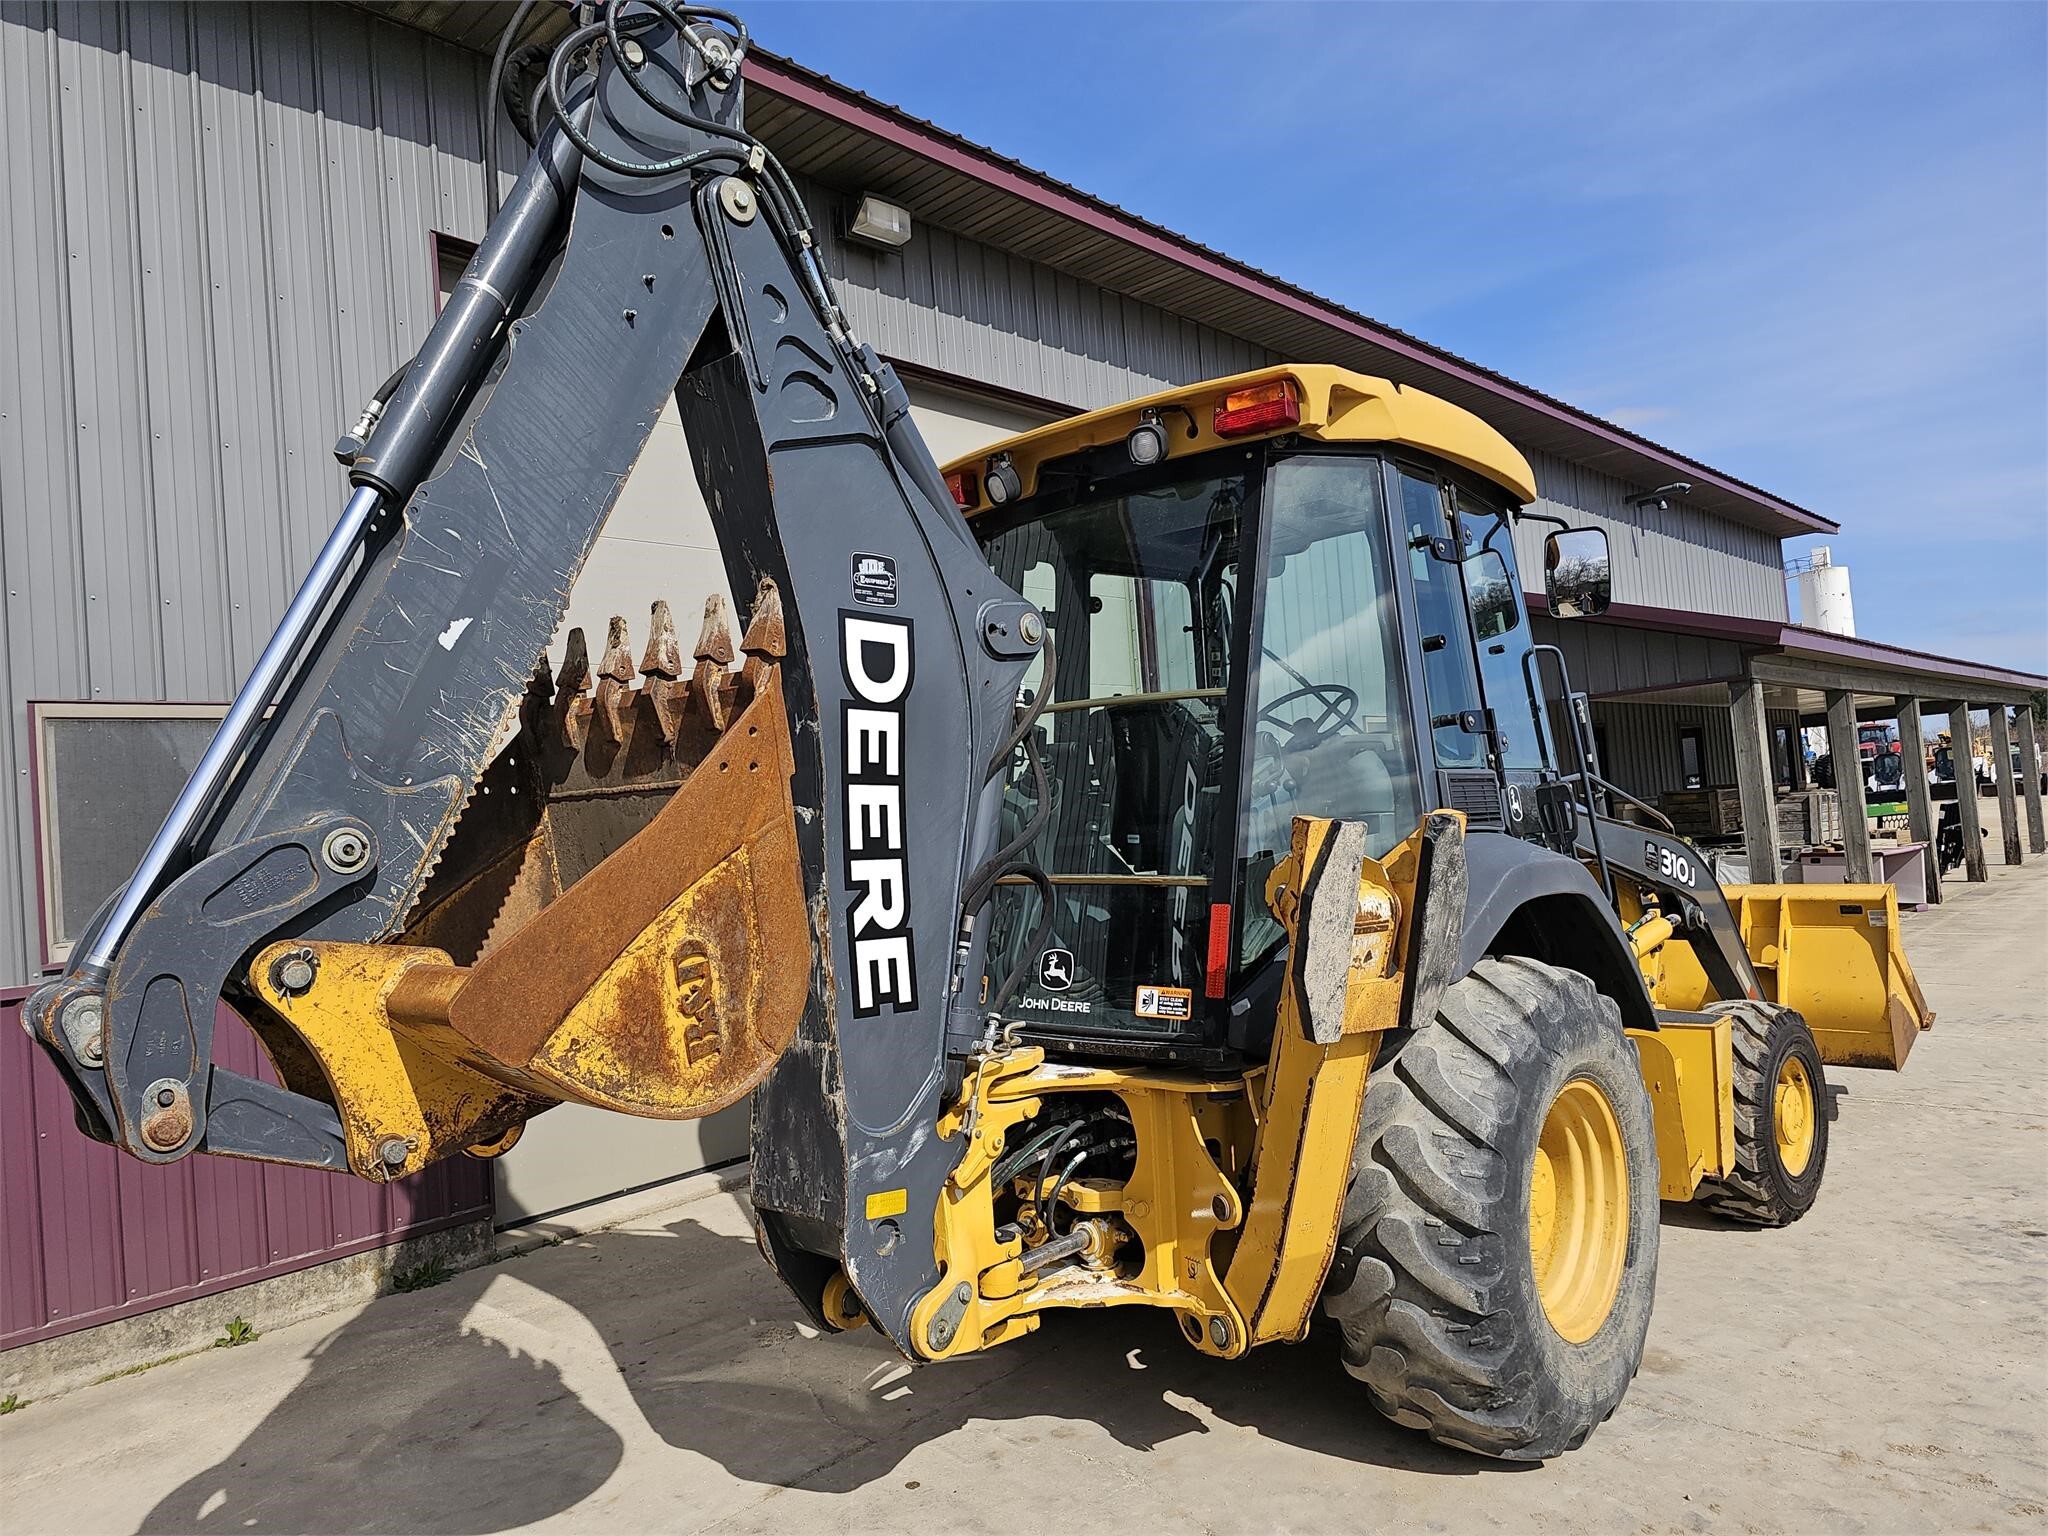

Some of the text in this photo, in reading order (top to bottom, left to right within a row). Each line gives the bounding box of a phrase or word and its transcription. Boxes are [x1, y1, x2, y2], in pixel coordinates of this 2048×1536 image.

[845, 618, 912, 1009] DEERE
[1661, 848, 1695, 887] 310J
[1051, 998, 1091, 1013] DEERE
